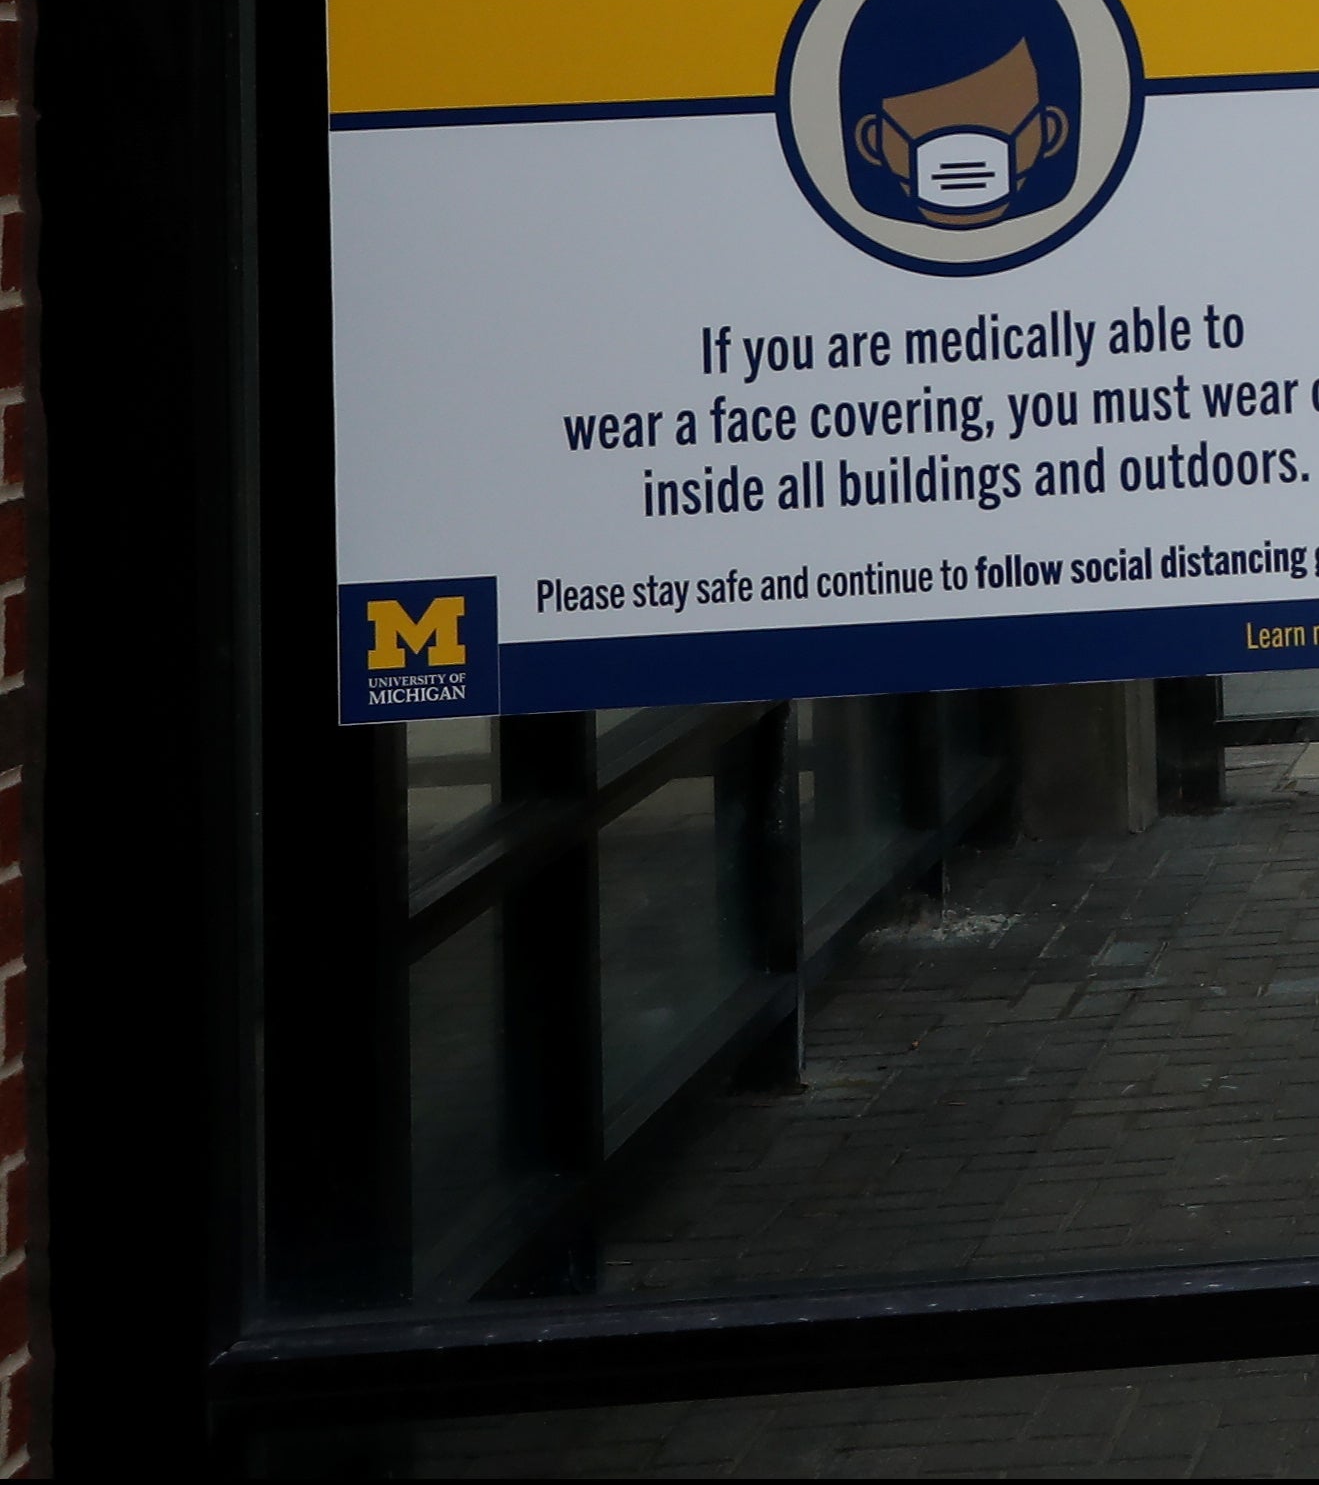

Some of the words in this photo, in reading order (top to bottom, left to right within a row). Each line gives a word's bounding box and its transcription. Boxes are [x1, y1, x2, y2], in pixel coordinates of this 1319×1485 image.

[702, 325, 732, 375] If
[742, 335, 814, 384] you
[828, 331, 891, 369] are
[905, 309, 1096, 368] medically
[1109, 305, 1191, 355] able
[1203, 304, 1244, 349] to
[563, 411, 663, 451] wear
[675, 410, 697, 446] a
[709, 395, 796, 444] face
[810, 385, 994, 442] covering,
[1007, 391, 1078, 440] you
[1093, 374, 1191, 424] must
[1202, 379, 1299, 418] wear
[644, 464, 764, 517] inside
[778, 460, 825, 510] all
[839, 453, 1022, 511] buildings
[1035, 446, 1105, 497] and
[1120, 440, 1310, 492] outdoors.
[537, 578, 625, 613] Please
[632, 574, 690, 614] stay
[696, 568, 753, 605] safe
[760, 565, 809, 601] and
[816, 561, 933, 598] continue
[939, 559, 968, 591] to
[974, 554, 1064, 590] follow
[1070, 546, 1153, 584] social
[1160, 540, 1308, 580] distancing
[367, 595, 466, 670] M
[1246, 622, 1306, 649] Learn
[368, 674, 447, 688] UNIVERSITY
[448, 672, 466, 682] OF
[368, 685, 466, 705] MICHIGAN
